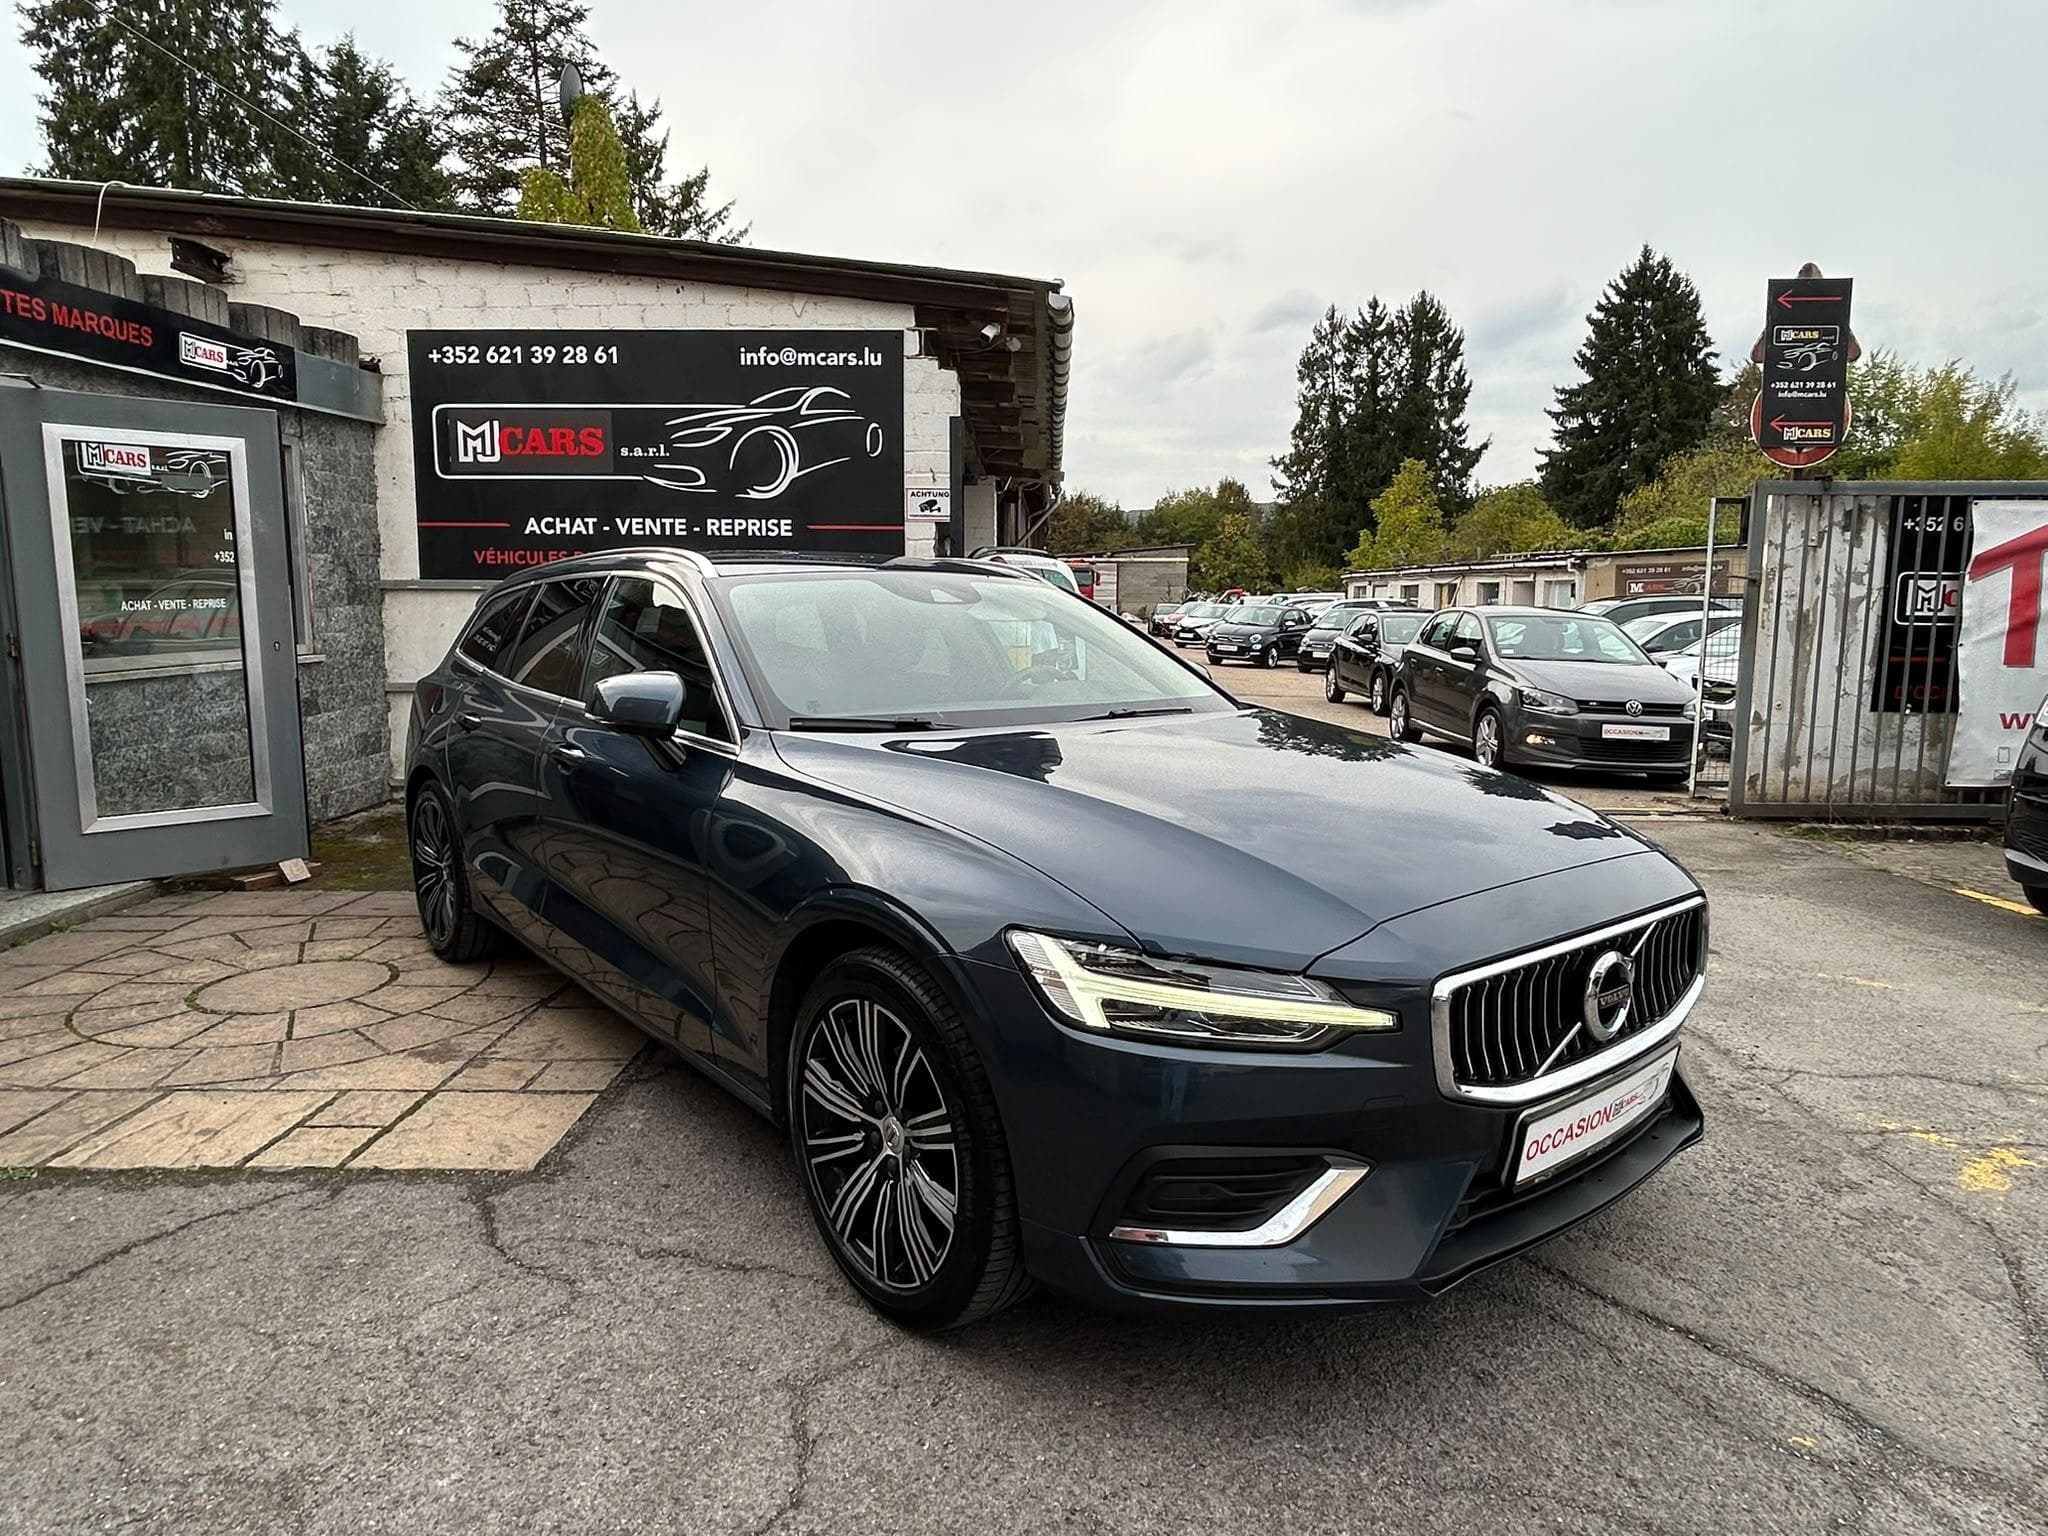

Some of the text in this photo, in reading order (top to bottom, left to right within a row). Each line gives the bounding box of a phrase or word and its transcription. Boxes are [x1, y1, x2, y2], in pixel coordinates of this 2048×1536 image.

[51, 303, 153, 347] MARQUES
[428, 346, 618, 364] +352 621 39 28 61
[740, 346, 882, 366] info@mcars.lu
[1790, 381, 1803, 389] 621
[620, 444, 670, 457] s.a.r.l.
[524, 517, 597, 535] ACHAT
[615, 518, 687, 536] VENTE
[707, 518, 793, 537] REPRISE
[214, 551, 235, 563] +352
[121, 600, 152, 611] ACHAT
[158, 599, 187, 611] VENTE
[192, 598, 227, 609] REPRISE
[1526, 1103, 1614, 1161] OCCASION
